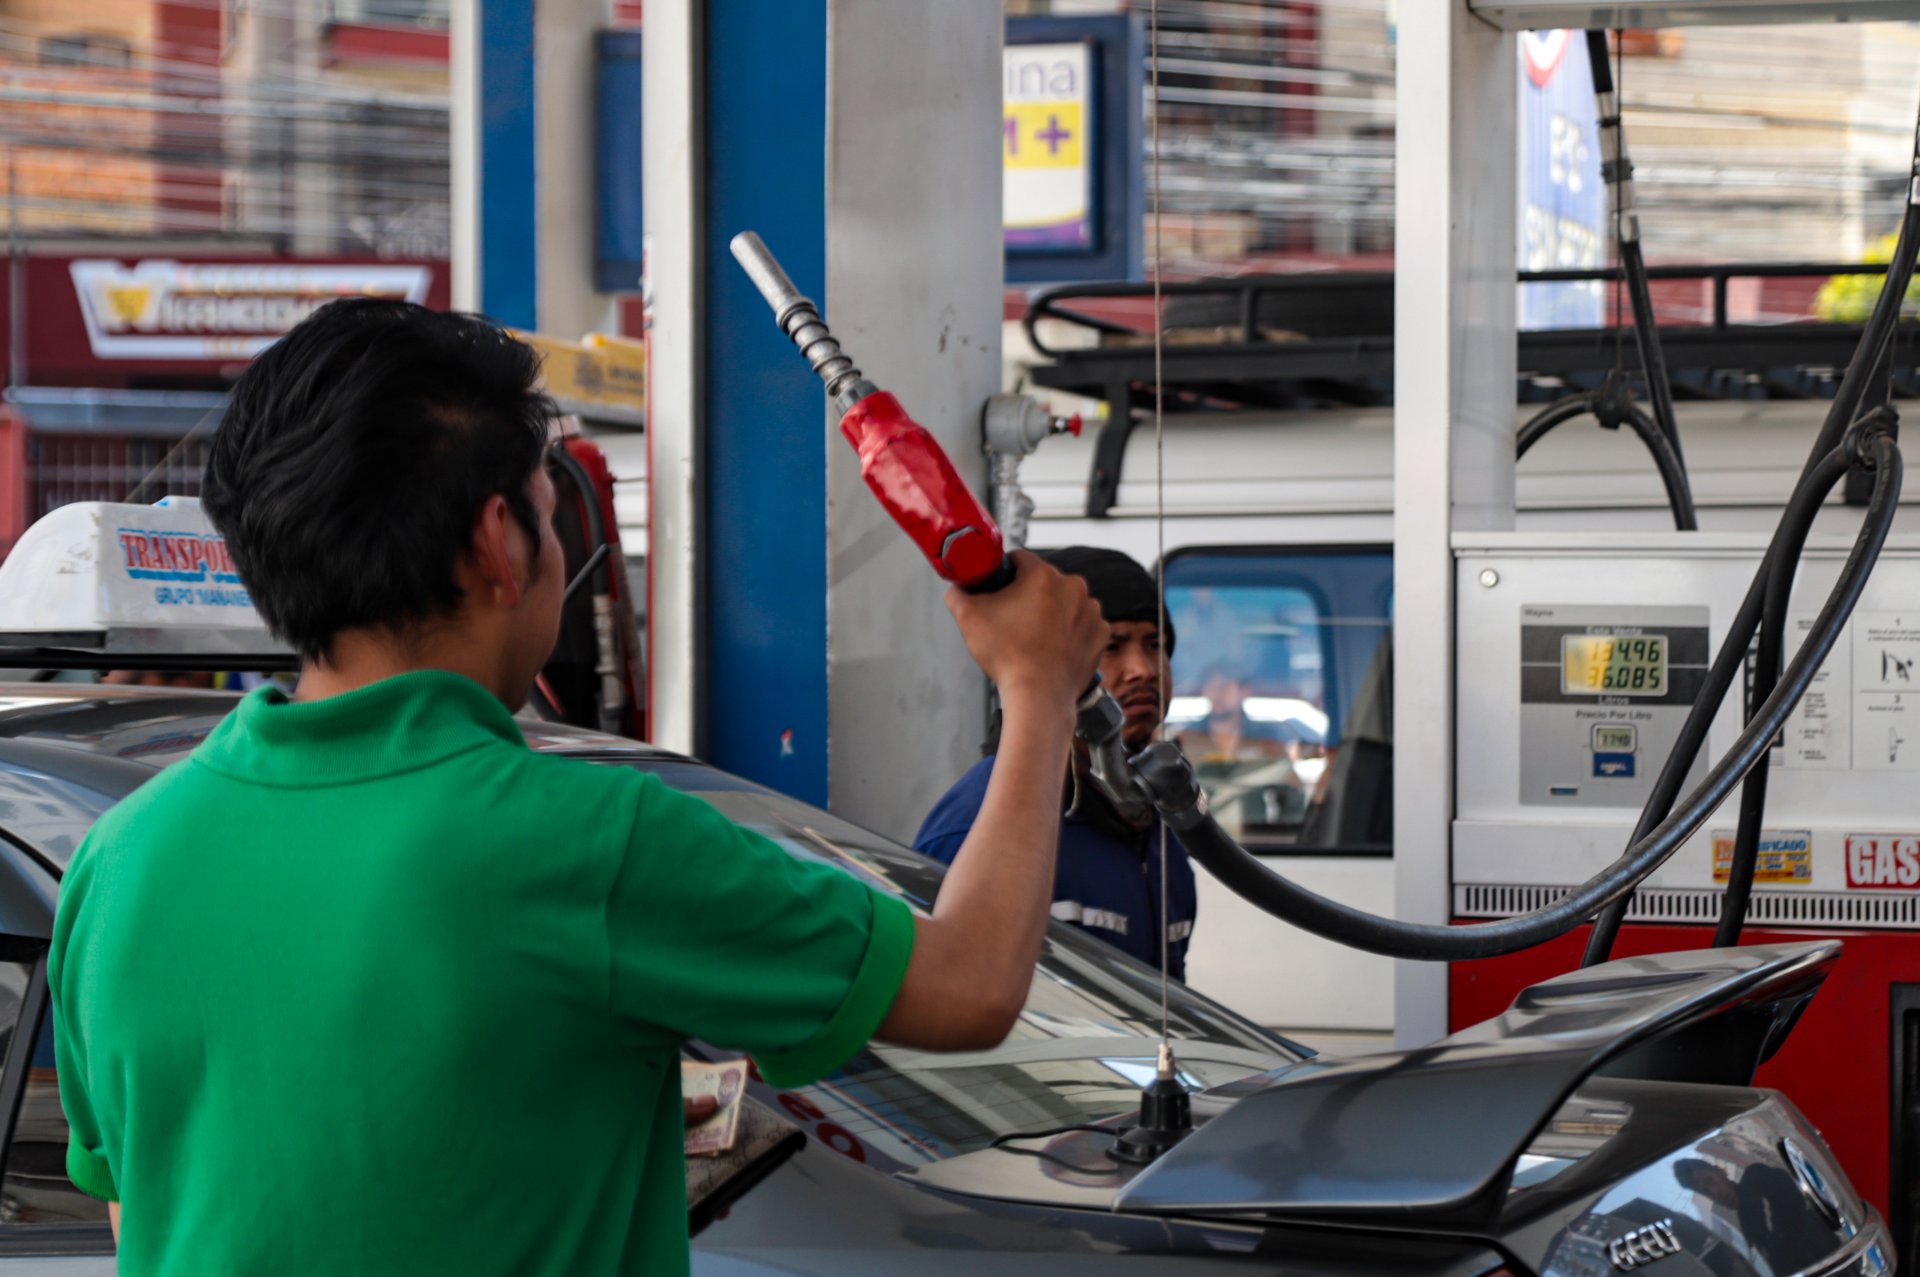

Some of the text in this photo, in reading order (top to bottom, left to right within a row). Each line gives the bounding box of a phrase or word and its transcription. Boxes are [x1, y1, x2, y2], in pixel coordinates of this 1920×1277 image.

[1575, 710, 1652, 721] Precio Por Litro
[1609, 1217, 1682, 1271] GEELY
